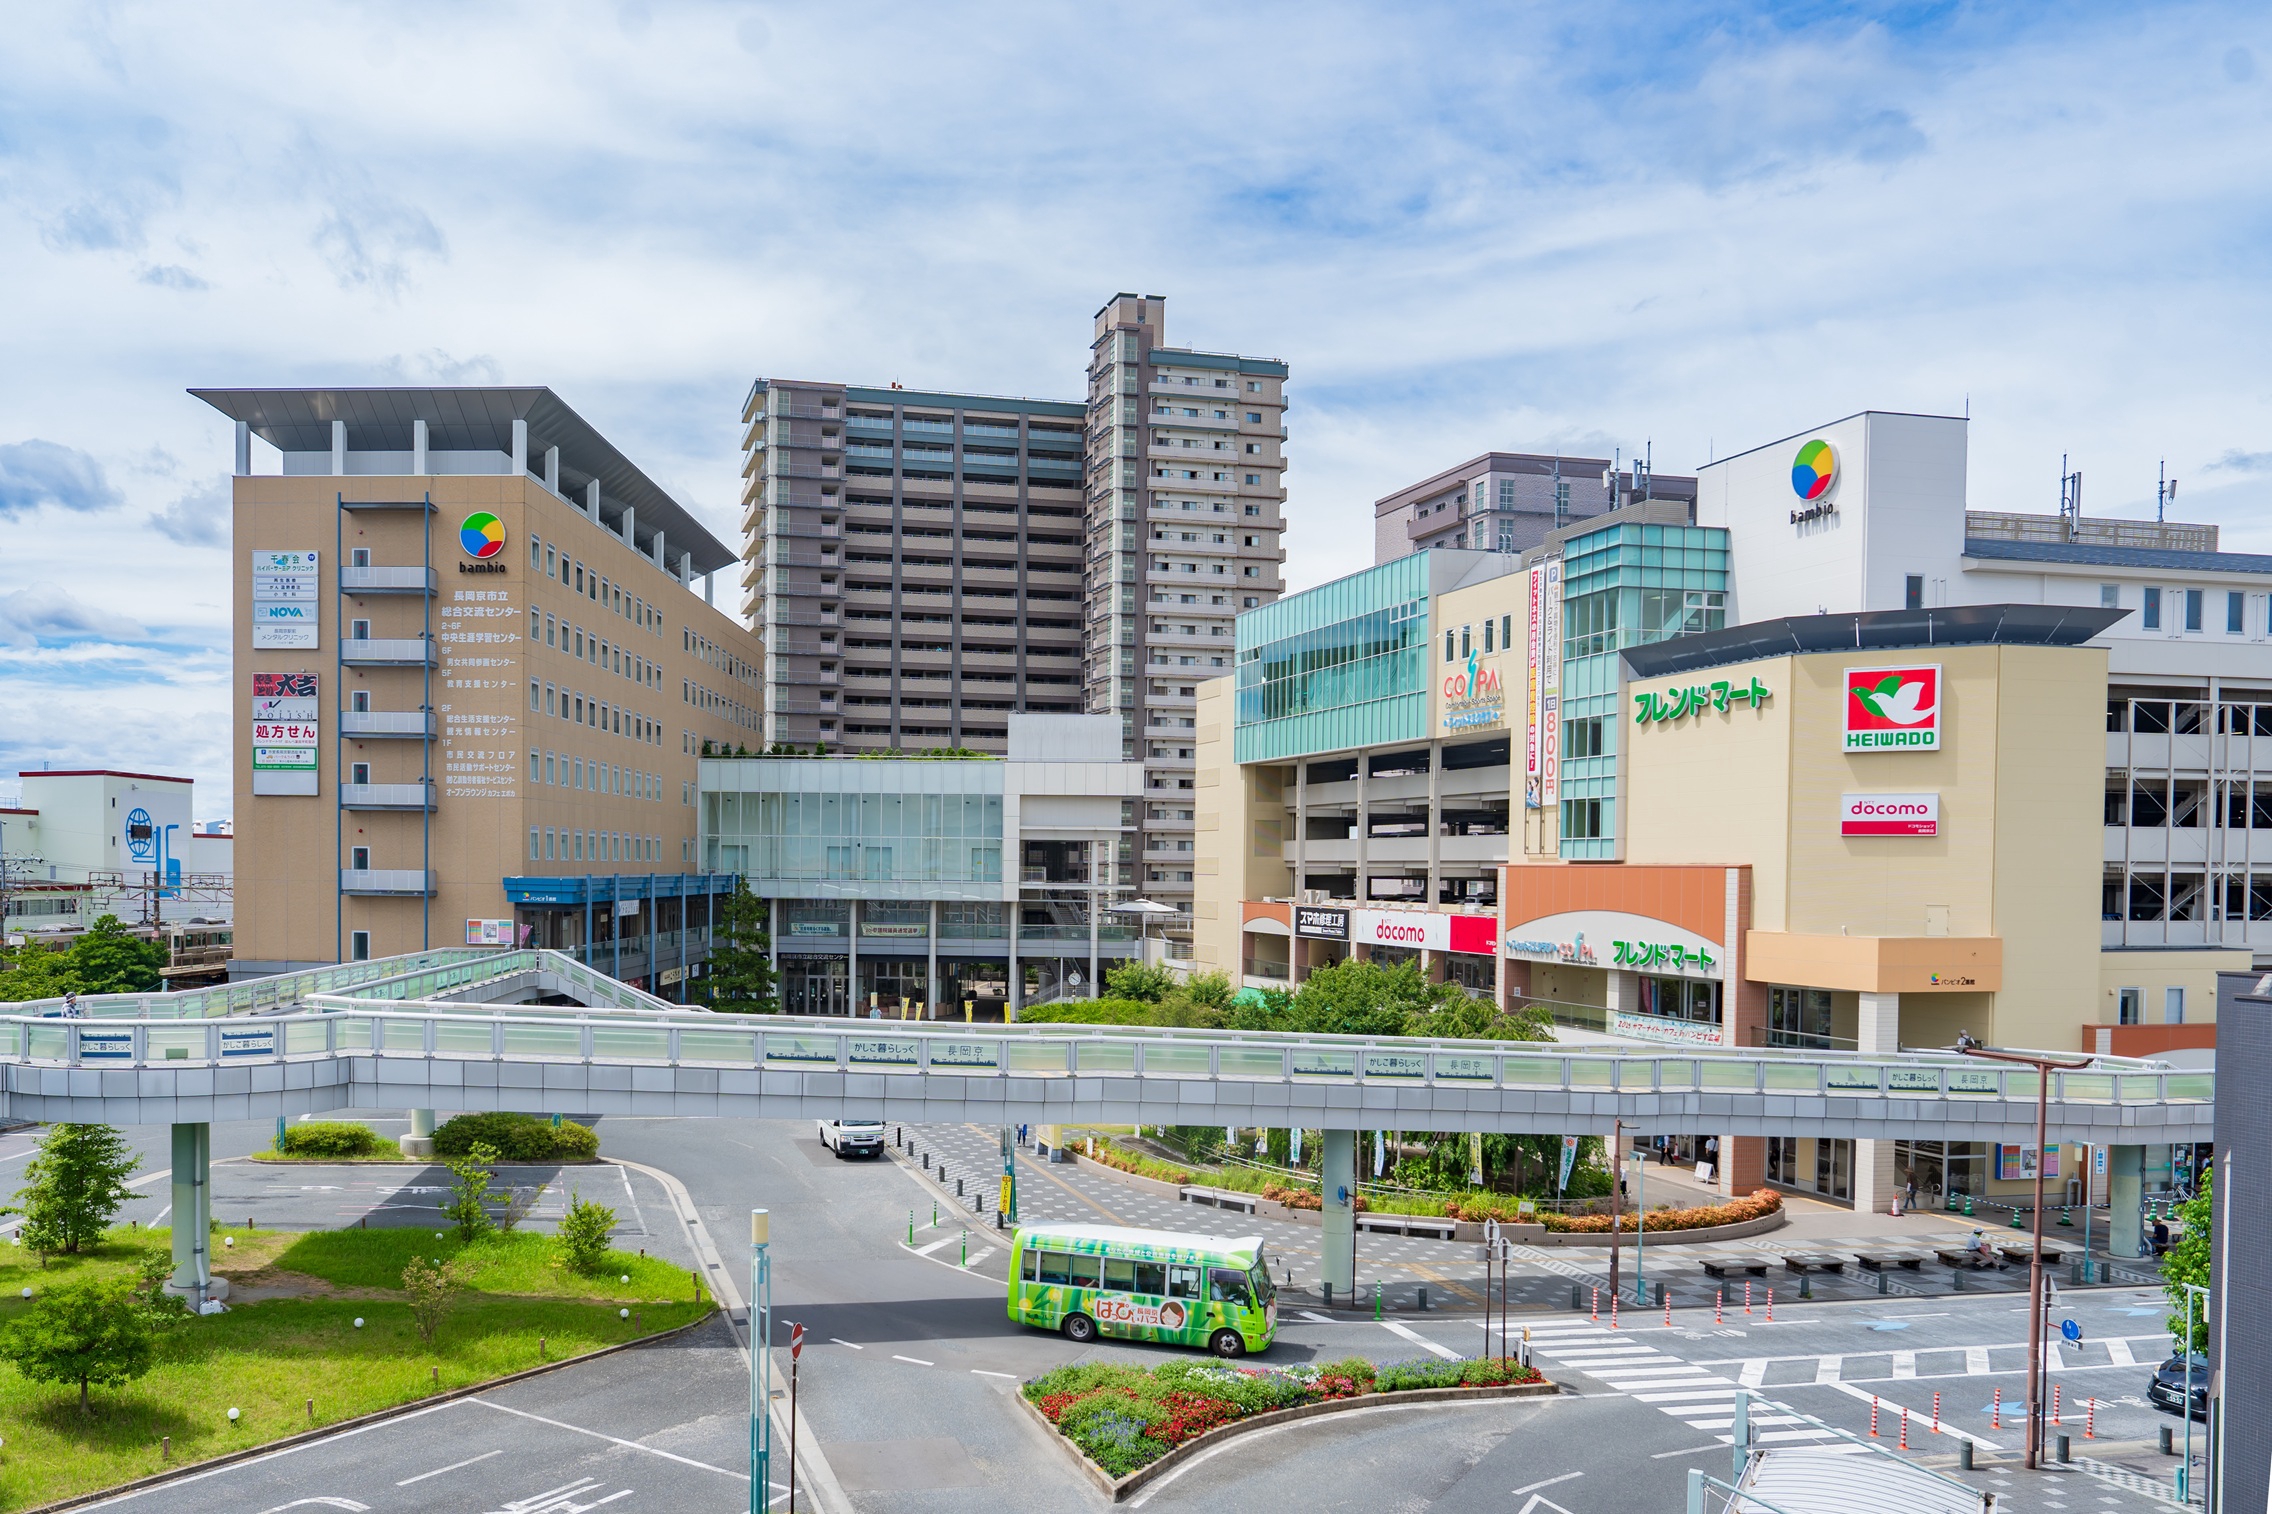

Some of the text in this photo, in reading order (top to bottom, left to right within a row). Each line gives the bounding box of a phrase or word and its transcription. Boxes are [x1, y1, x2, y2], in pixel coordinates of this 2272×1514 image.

[1791, 501, 1834, 524] bambio
[459, 561, 506, 573] bambio
[454, 591, 508, 601] 長岡京市立
[270, 607, 304, 618] NOVA
[441, 606, 522, 617] 総合交流センター
[441, 632, 522, 643] 中央生涯学習センター
[441, 646, 452, 655] 6F
[441, 669, 452, 677] 5F
[275, 674, 317, 697] 大吉
[1634, 676, 1771, 723] フレンドマート
[441, 704, 452, 712] 2F
[256, 725, 315, 738] 処方せん
[442, 739, 452, 747] 1F
[1847, 731, 1935, 747] HEIWADO
[1851, 801, 1928, 815] docomo
[1300, 911, 1345, 927] スマホ修理工房
[1376, 919, 1425, 942] docomo
[1612, 940, 1715, 970] フレンドマート
[81, 1042, 131, 1051] かしこ暮らしっく
[223, 1039, 272, 1049] かしこ暮らしっく
[854, 1042, 914, 1054] かしこ暮らしっく
[947, 1045, 984, 1057] 長岡京
[1369, 1057, 1421, 1067] かしこ暮らしっく
[1450, 1060, 1482, 1070] 長岡京
[1892, 1073, 1937, 1082] かしこ暮らしっく
[1961, 1075, 1988, 1085] 長岡京
[1137, 1307, 1159, 1316] 長岡京
